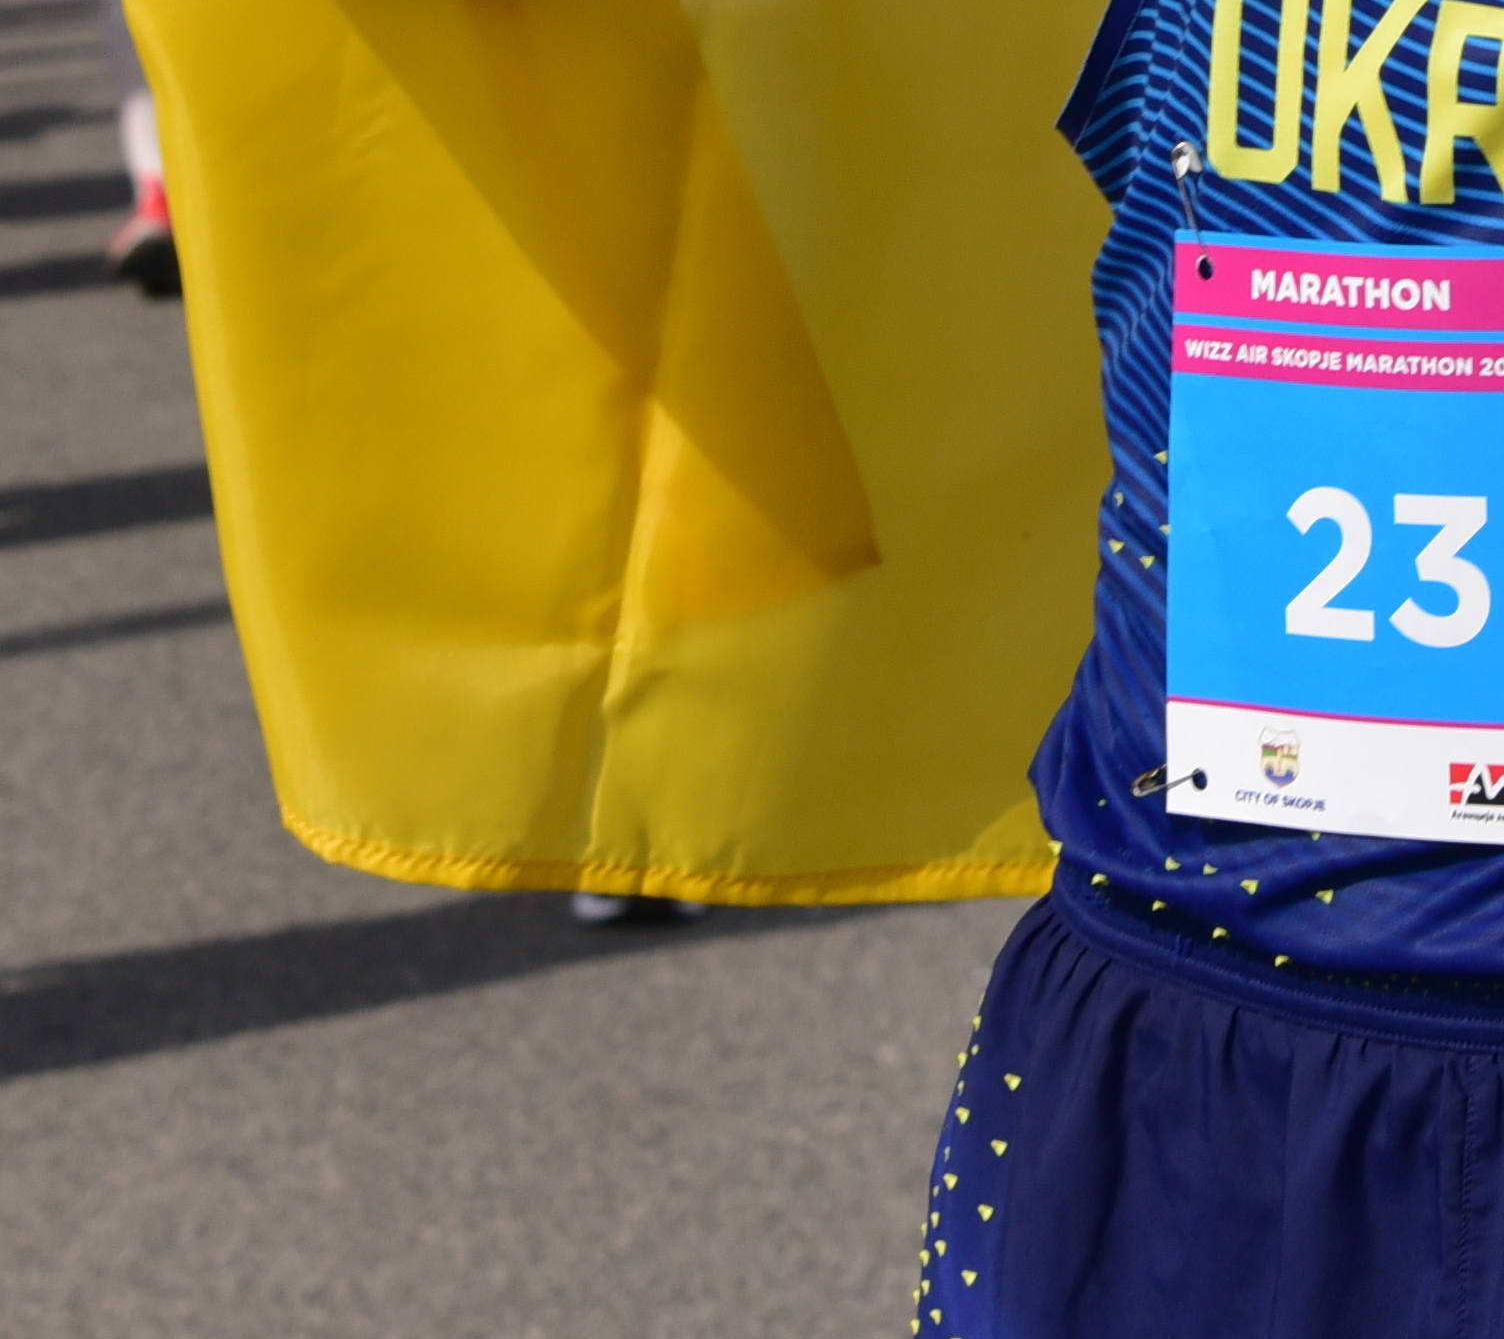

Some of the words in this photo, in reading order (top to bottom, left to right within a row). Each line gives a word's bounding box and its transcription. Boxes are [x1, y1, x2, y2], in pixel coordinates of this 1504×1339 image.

[1251, 268, 1451, 311] MARATHON
[1185, 339, 1234, 361] WIZZ
[1235, 343, 1268, 365] AIR
[1271, 347, 1342, 372] SKOPJE
[1347, 353, 1473, 377] MARATHON
[1284, 486, 1491, 649] 23
[1235, 789, 1261, 803] CITY
[1264, 793, 1279, 804] OF
[1282, 795, 1326, 811] SKOPJE
